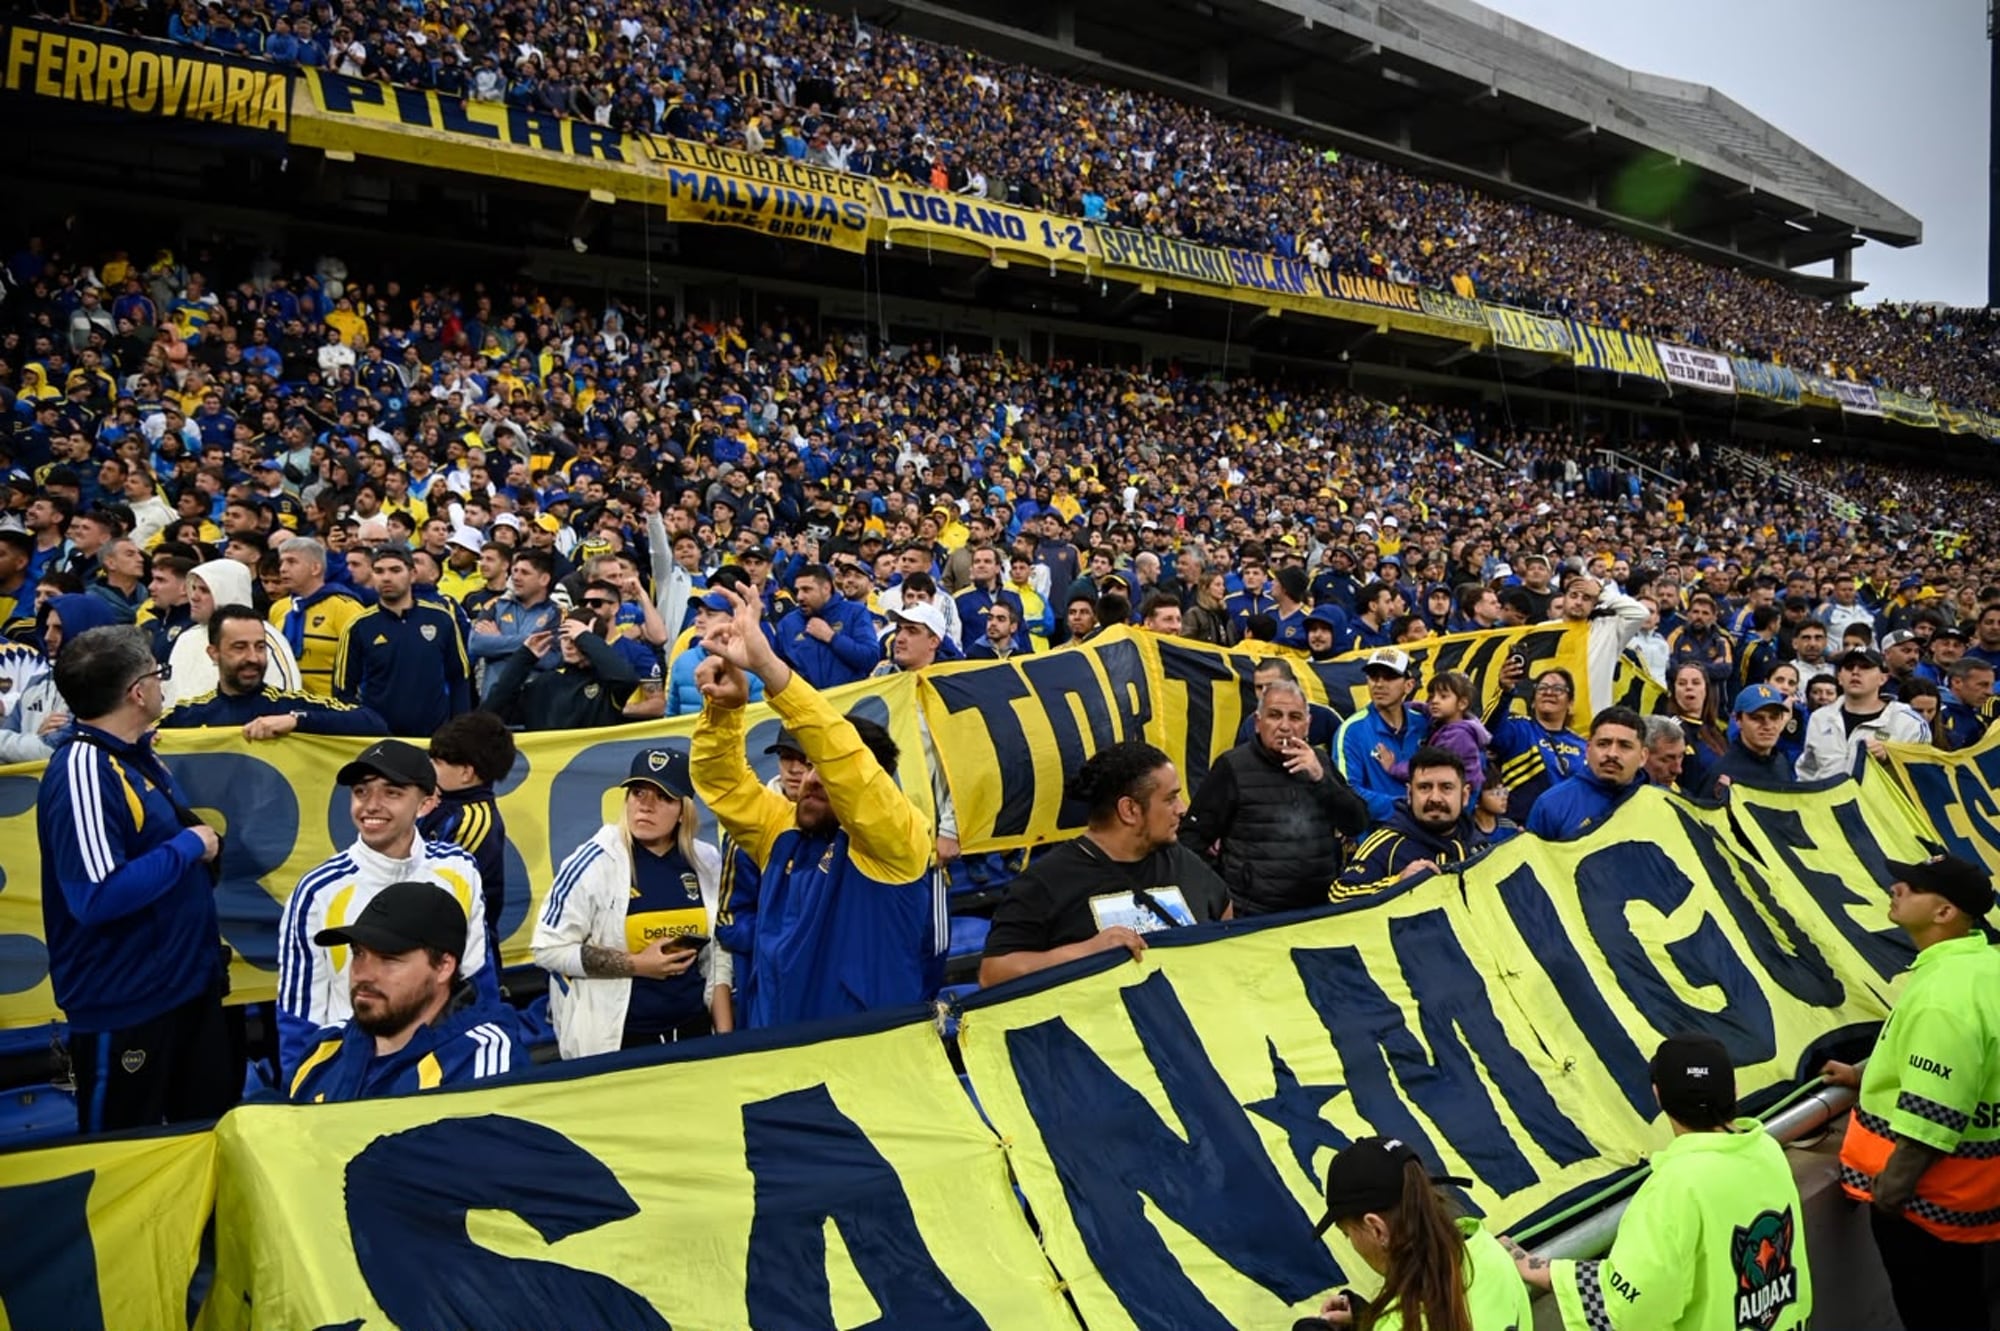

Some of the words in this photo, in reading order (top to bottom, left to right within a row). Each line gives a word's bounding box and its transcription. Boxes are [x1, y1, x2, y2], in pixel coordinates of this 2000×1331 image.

[6, 27, 288, 133] FERROVIARIA
[316, 69, 625, 163] PILAR
[650, 137, 688, 163] LA
[688, 145, 790, 184] LOCURA
[794, 164, 867, 201] CRECE
[667, 168, 868, 232] MALVINAS
[878, 185, 1027, 242] LUGANO
[767, 217, 832, 242] BROWN
[1101, 227, 1230, 283] SPEGAZZINI
[1338, 271, 1421, 312] DIAMANTE
[644, 924, 699, 940] betsson
[1738, 1272, 1791, 1324] AUDAX
